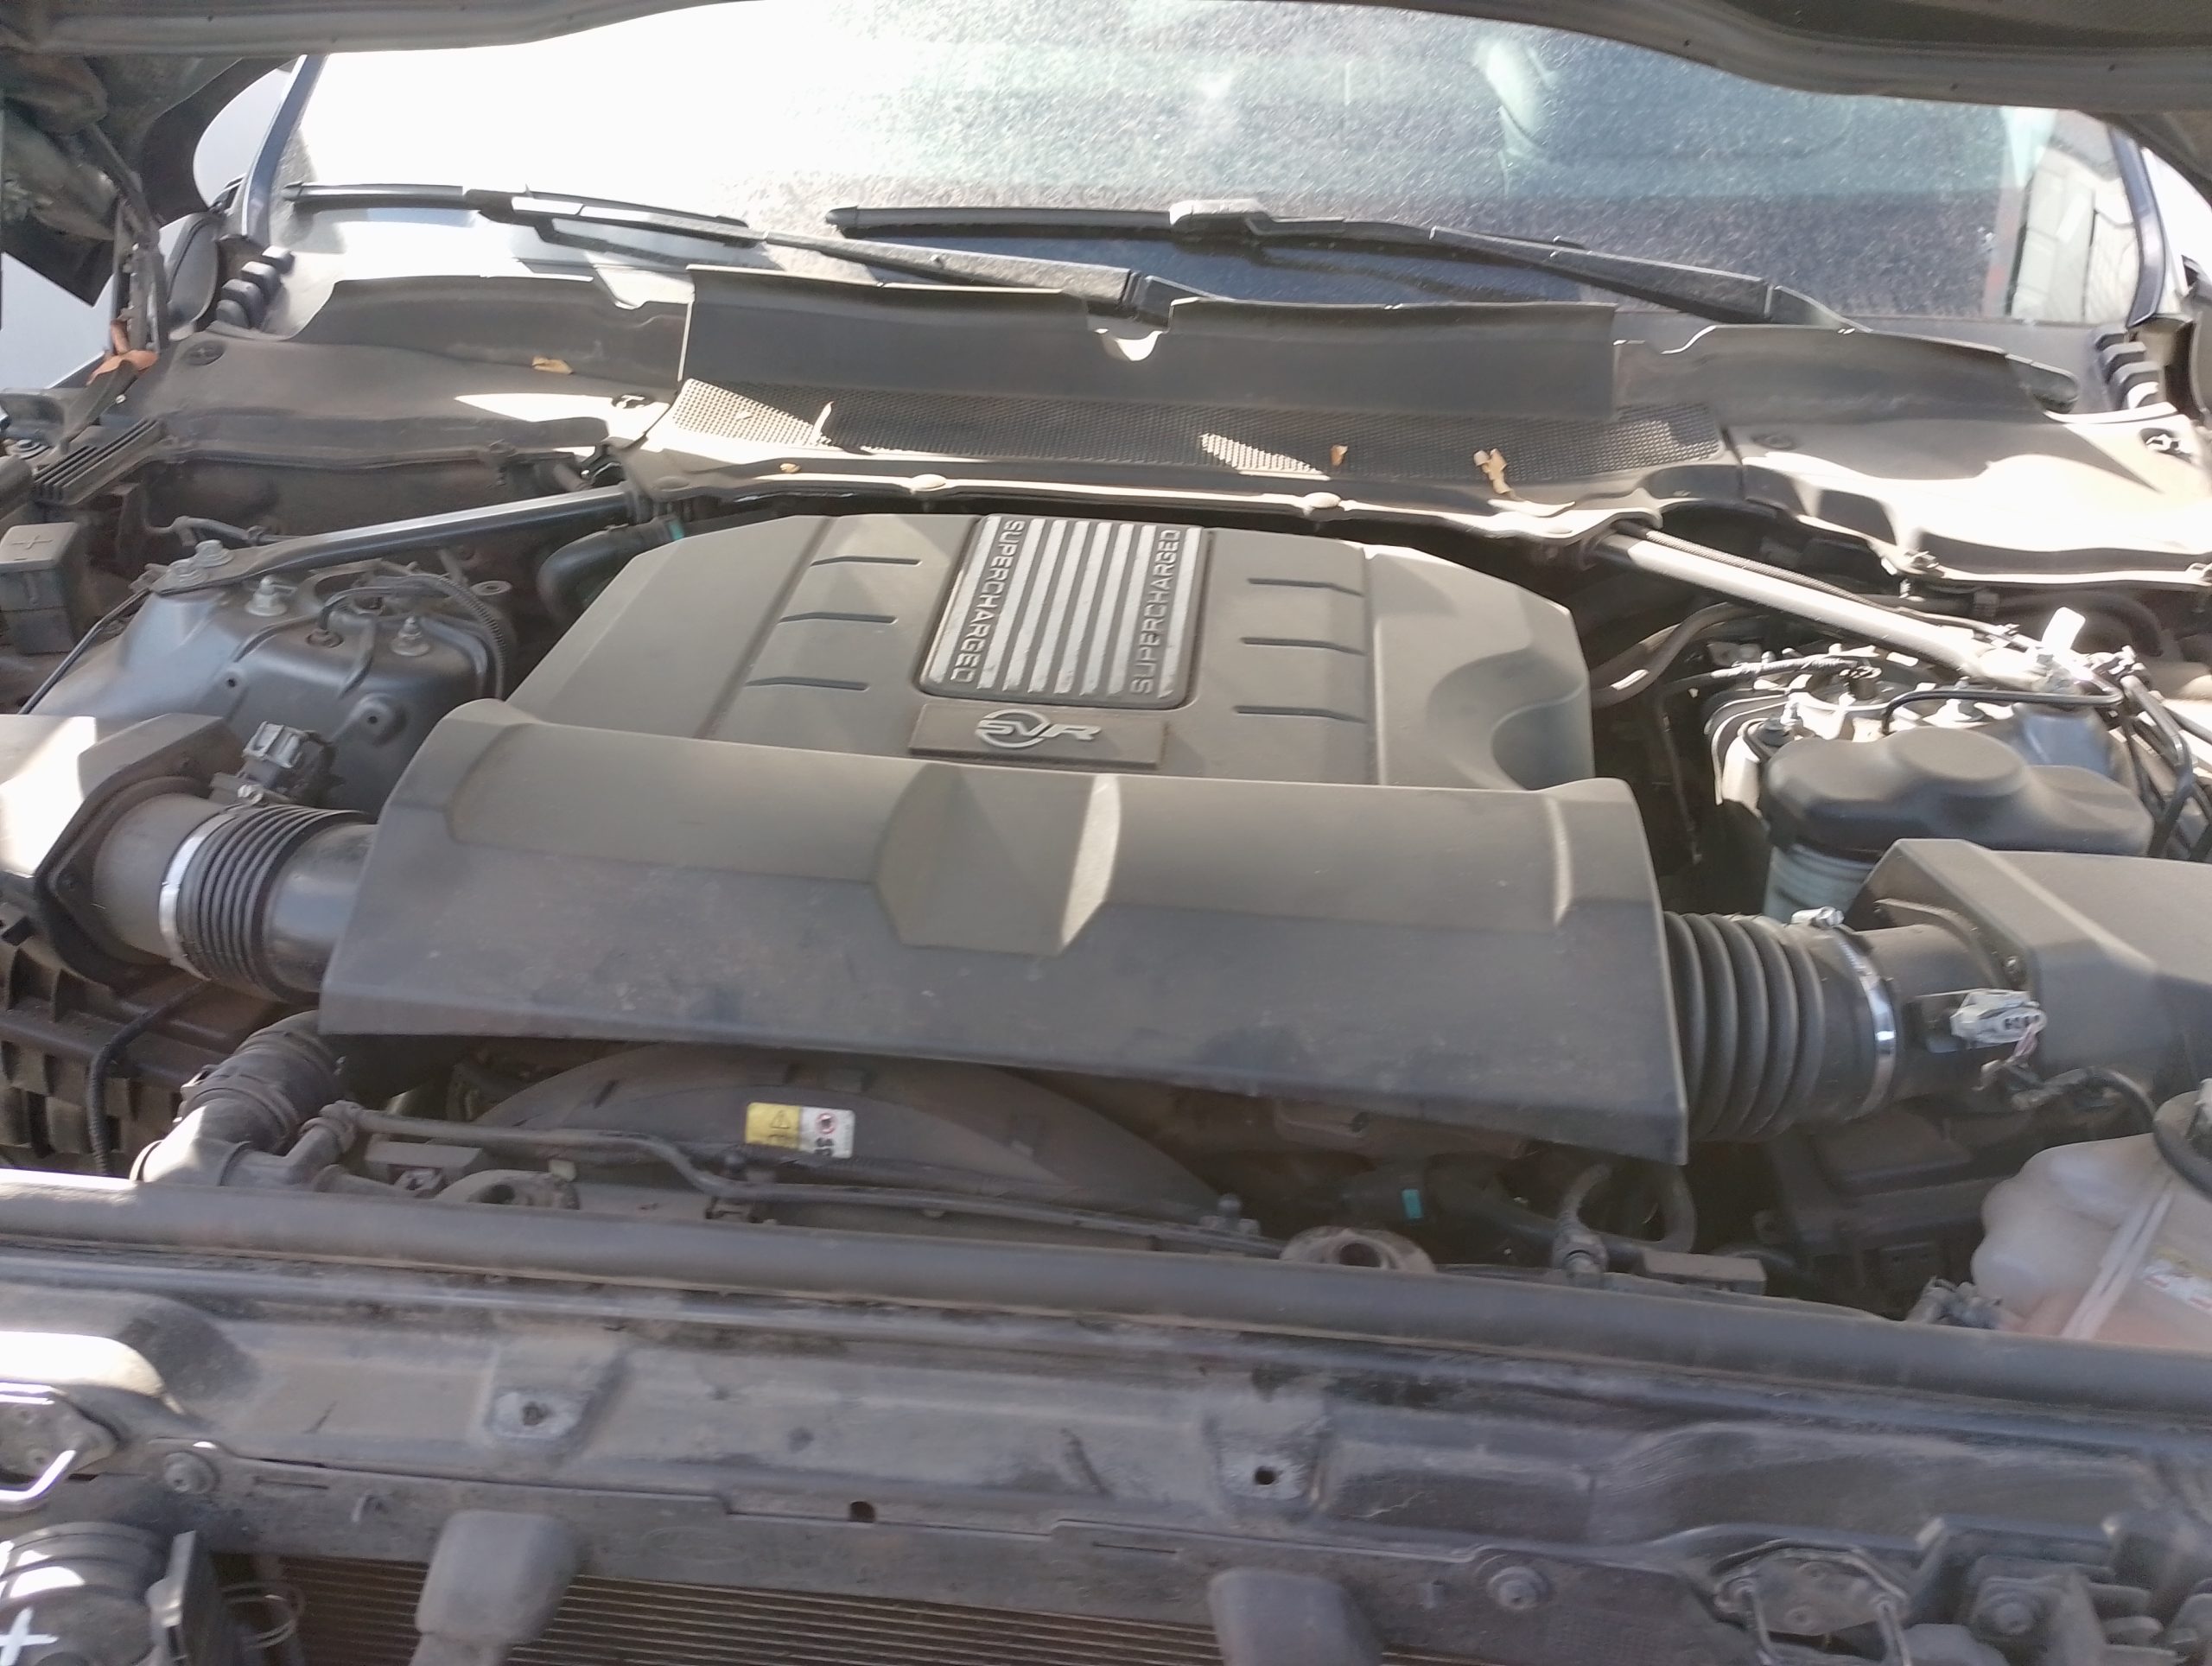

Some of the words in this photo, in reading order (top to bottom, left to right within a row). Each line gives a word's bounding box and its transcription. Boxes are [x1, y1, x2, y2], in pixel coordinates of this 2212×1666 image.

[950, 518, 1025, 684] SUPERCHARGED
[1131, 529, 1181, 694] SUPERCHARGED
[975, 716, 1102, 742] SVR
